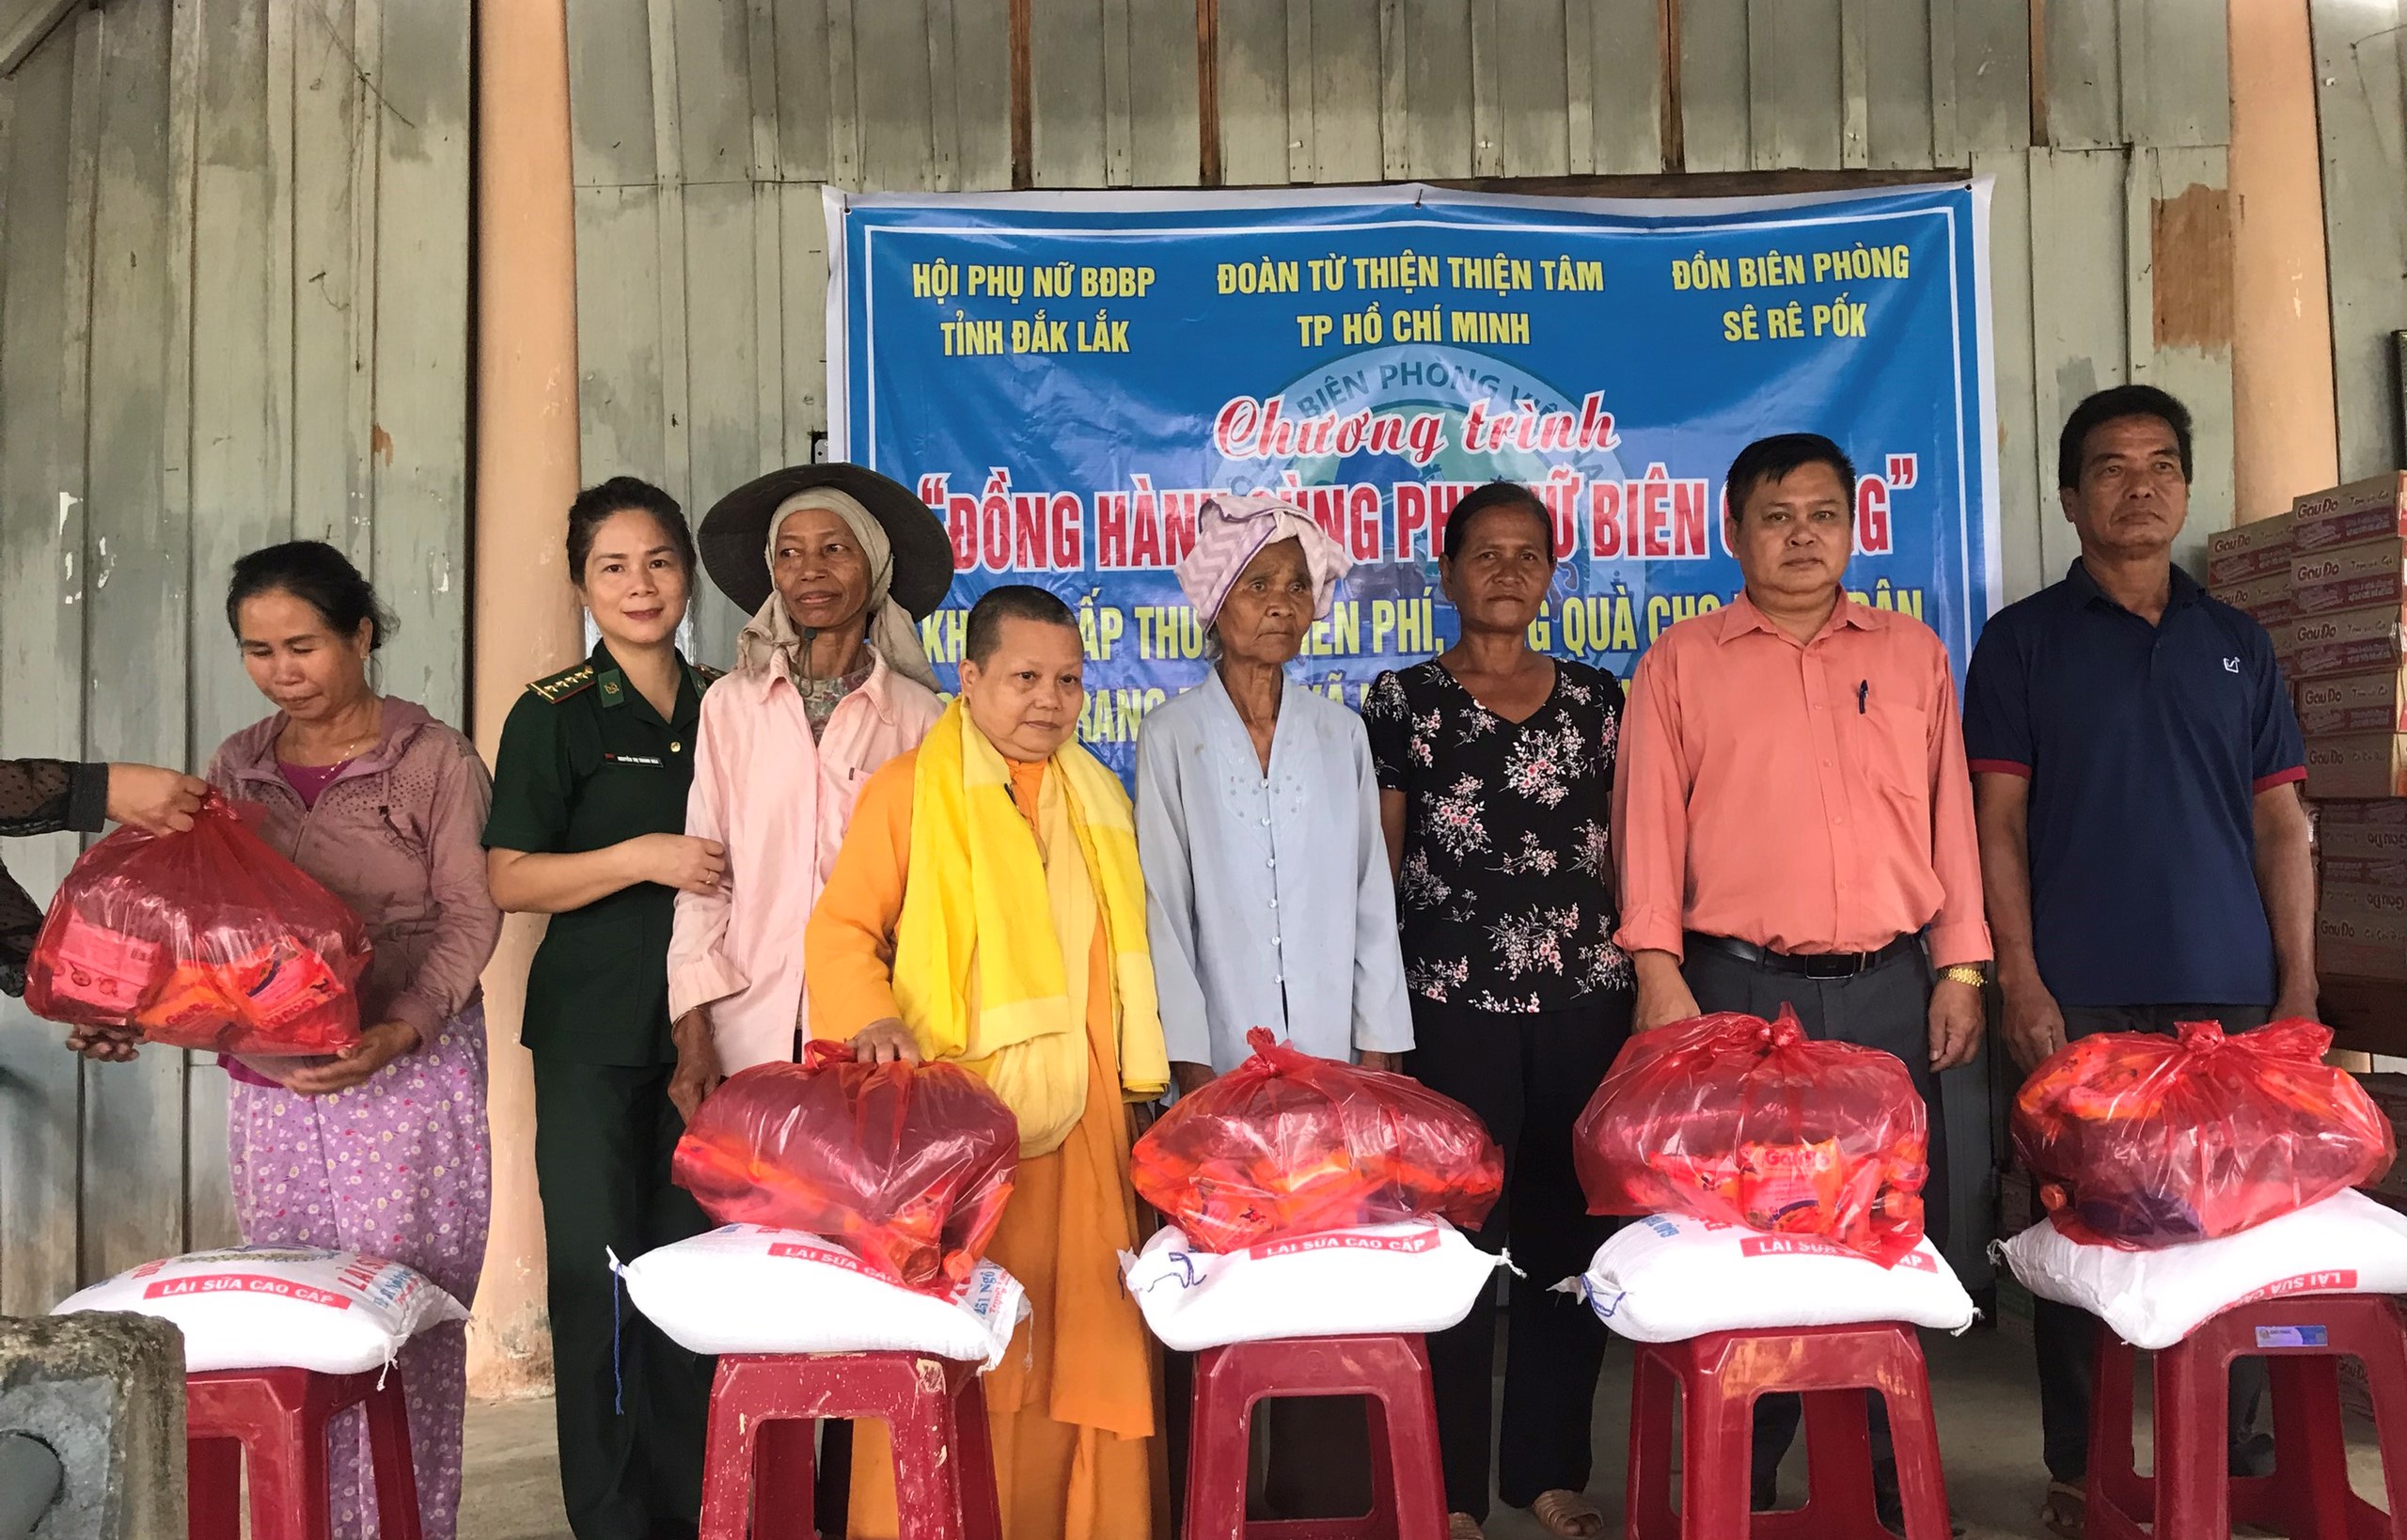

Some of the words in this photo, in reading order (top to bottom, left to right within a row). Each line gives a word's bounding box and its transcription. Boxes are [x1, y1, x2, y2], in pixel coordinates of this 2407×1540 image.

[913, 258, 959, 305] HỘI
[968, 265, 1025, 305] PHỤ
[1033, 260, 1076, 299] NỮ
[1081, 268, 1156, 298] BĐBP
[1217, 256, 1299, 295] ĐOÀN
[1308, 256, 1347, 292] TỪ
[1353, 249, 1439, 295] THIỆN
[1447, 252, 1533, 297] THIỆN
[1540, 254, 1604, 291] TÂM
[1672, 249, 1732, 291] ĐỒN
[1738, 249, 1806, 289] BIÊN
[1813, 244, 1911, 283] PHÒNG
[940, 310, 1004, 356] TỈNH
[1012, 309, 1069, 354] ĐẮK
[1078, 308, 1130, 354] LẮK
[1297, 315, 1333, 348] TP
[1343, 301, 1384, 345] HỒ
[1392, 305, 1442, 344] CHÍ
[1451, 311, 1531, 346] MINH
[1723, 304, 1760, 342] SÊ
[1767, 301, 1805, 339] RÊ
[1813, 291, 1868, 338] PỐK
[1379, 359, 1502, 401] PHÒNG
[1217, 398, 1446, 463] Chương
[1462, 393, 1619, 452] trình
[1098, 473, 1228, 569] HÀN
[1592, 465, 1707, 558] BIÊN
[921, 609, 968, 664] KH
[1078, 587, 1124, 661] ẤP
[1134, 605, 1204, 660] THU
[1562, 584, 1638, 657] QUÀ
[1345, 1237, 1383, 1249] CAO
[249, 1280, 290, 1295] CAO
